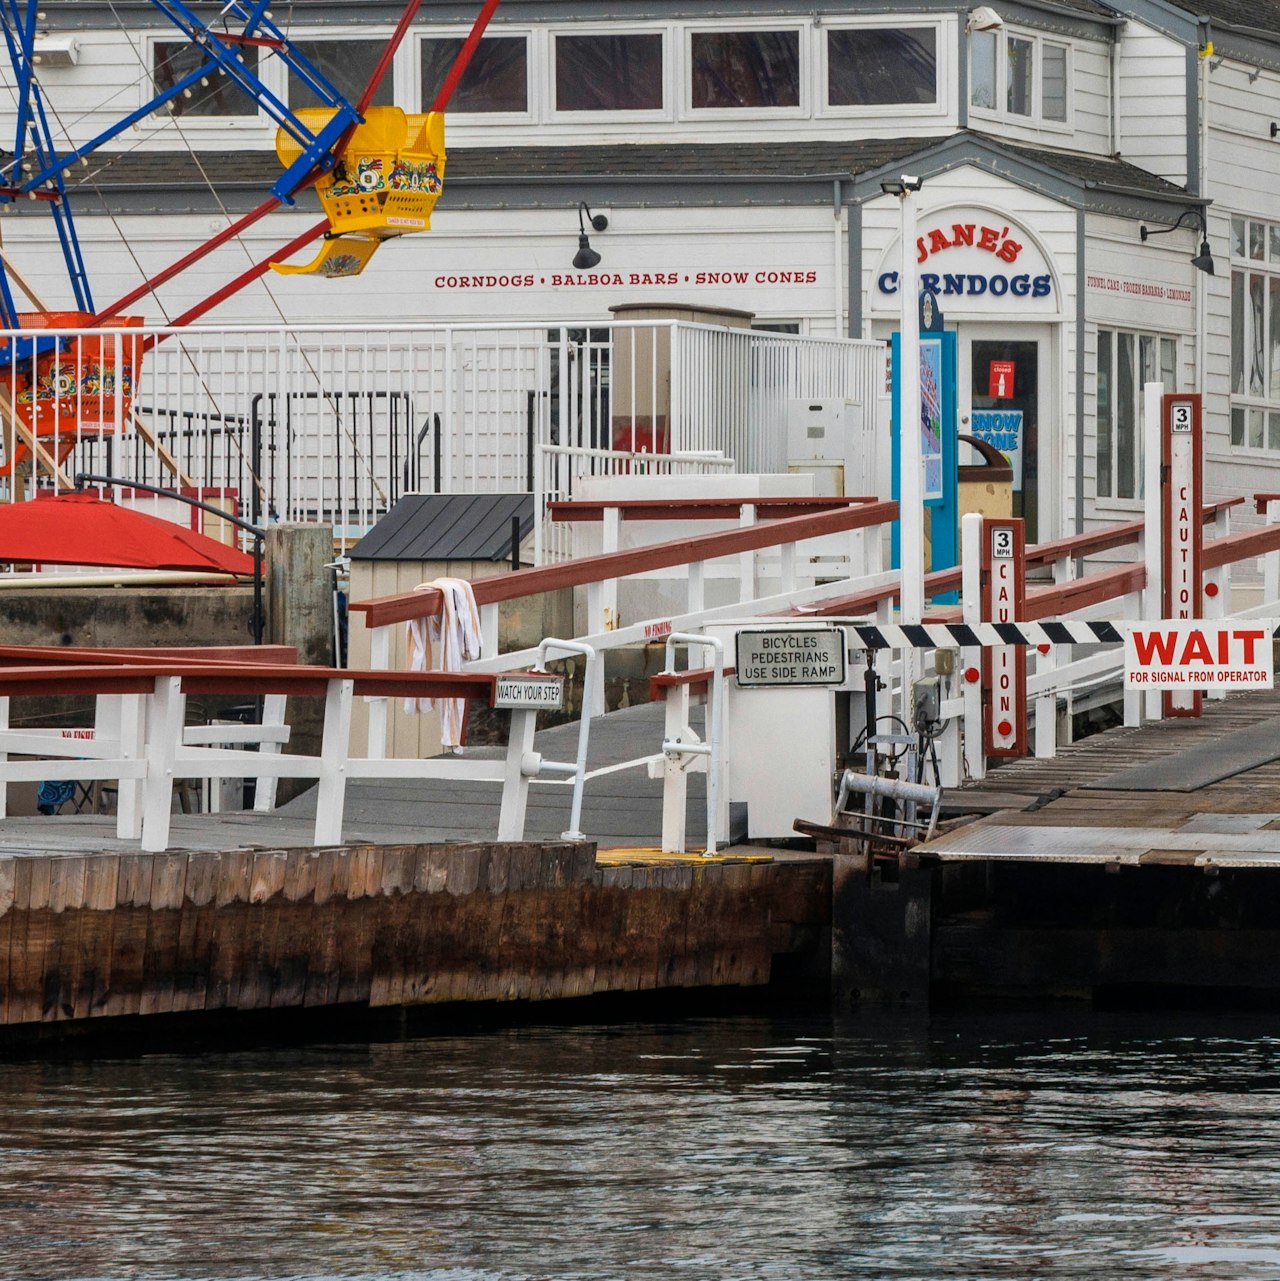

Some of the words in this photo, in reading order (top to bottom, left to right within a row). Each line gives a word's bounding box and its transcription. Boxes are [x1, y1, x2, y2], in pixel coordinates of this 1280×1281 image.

[917, 223, 1023, 264] JANE'S
[435, 274, 535, 288] CORNDOGS
[551, 273, 624, 287] BALBOA
[629, 272, 679, 286] BARS
[695, 272, 748, 285] SNOW
[755, 271, 818, 284] CONES
[878, 271, 1052, 297] CRNDOGS
[1087, 276, 1106, 289] FUNNEL
[1107, 279, 1120, 291] CAKE
[1123, 282, 1141, 295] FROZEN
[1142, 284, 1163, 298] BANANAS
[1166, 288, 1191, 302] LEMONADE
[972, 412, 1022, 432] SNOW
[1176, 408, 1188, 422] 3
[1175, 423, 1189, 431] MPH
[997, 532, 1009, 548] 3
[996, 548, 1011, 556] MPH
[762, 637, 818, 649] BICYCLES
[999, 563, 1010, 712] CAUION
[1132, 630, 1265, 666] WAIT
[751, 651, 829, 664] PEDESTRIANS
[745, 667, 769, 679] USE
[771, 666, 796, 679] SIDE
[802, 666, 836, 678] RAMP
[1130, 671, 1149, 683] FOR
[1151, 671, 1185, 682] SIGNAL
[1188, 671, 1215, 682] FROM
[1217, 671, 1267, 682] OPERATOR
[498, 684, 521, 701] WATCH
[523, 685, 542, 701] YOUR
[543, 685, 560, 701] STEP
